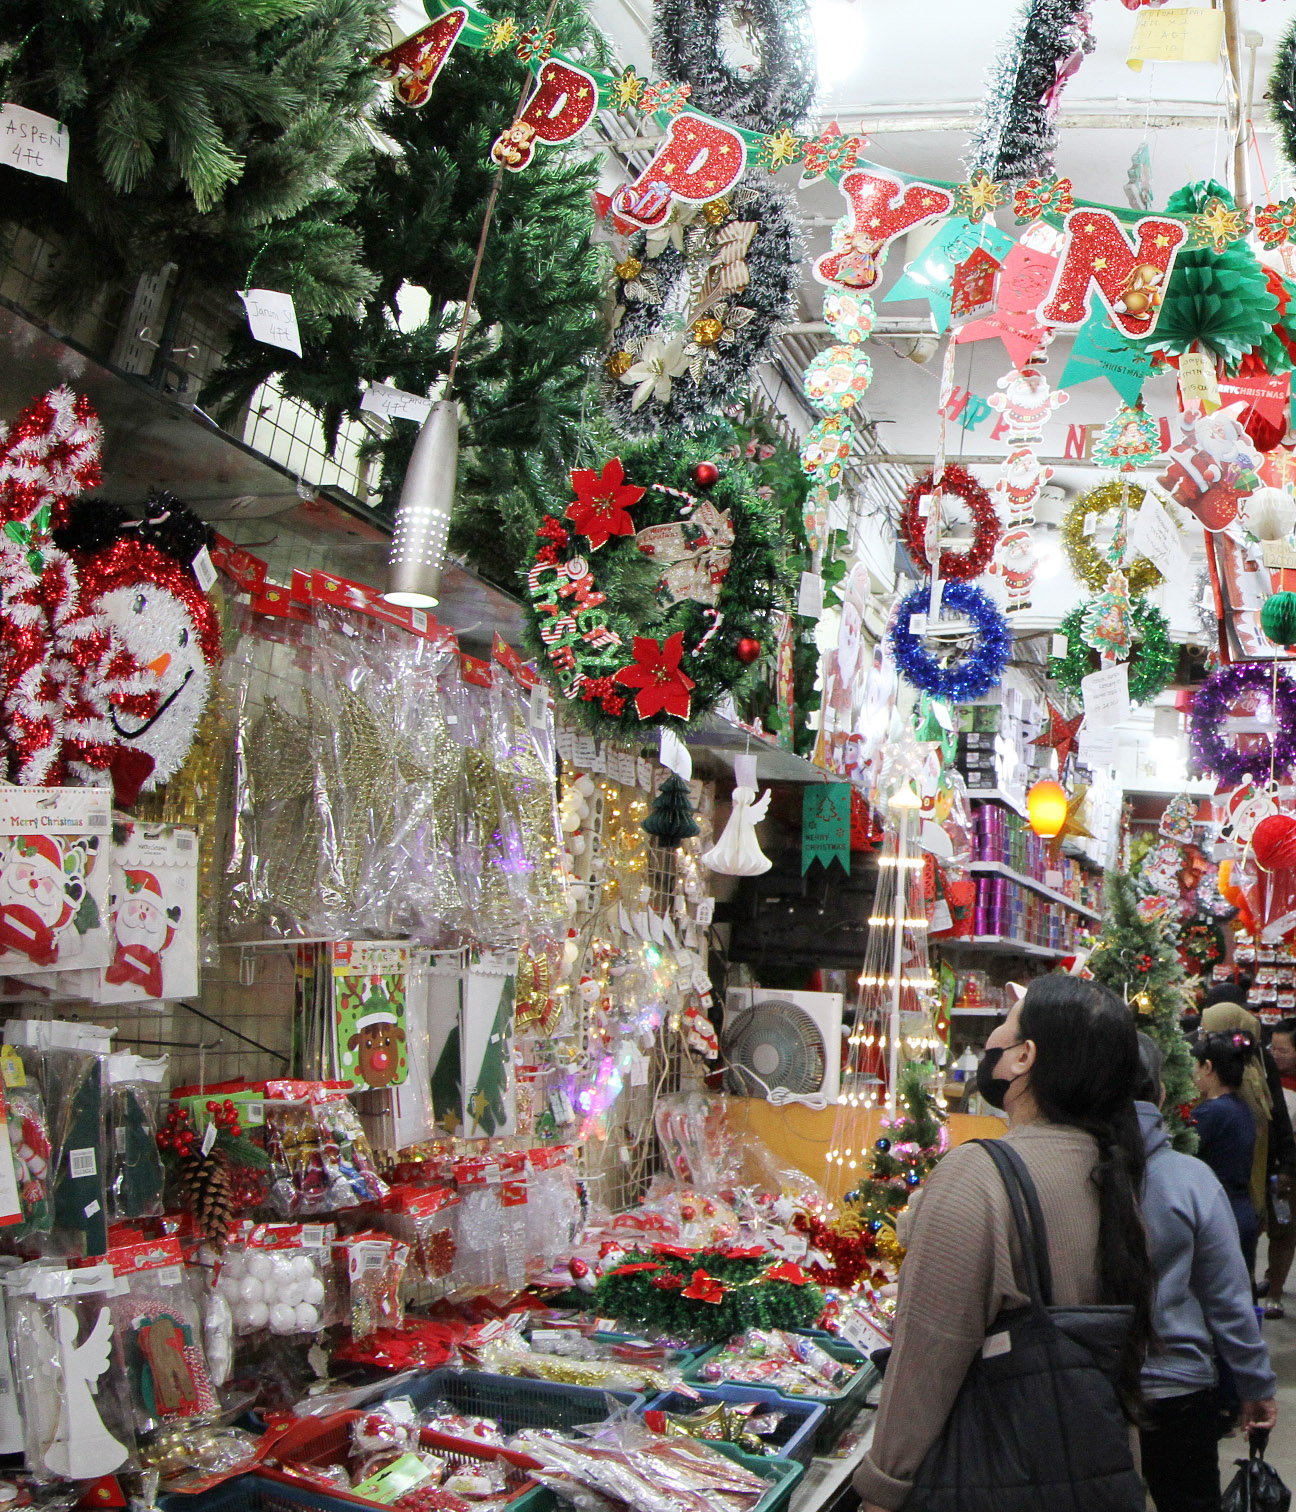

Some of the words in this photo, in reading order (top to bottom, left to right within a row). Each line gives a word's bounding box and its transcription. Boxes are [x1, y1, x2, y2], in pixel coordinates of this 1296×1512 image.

[6, 119, 61, 148] ASPEN
[10, 815, 39, 829] Merry
[40, 815, 84, 828] Christmas
